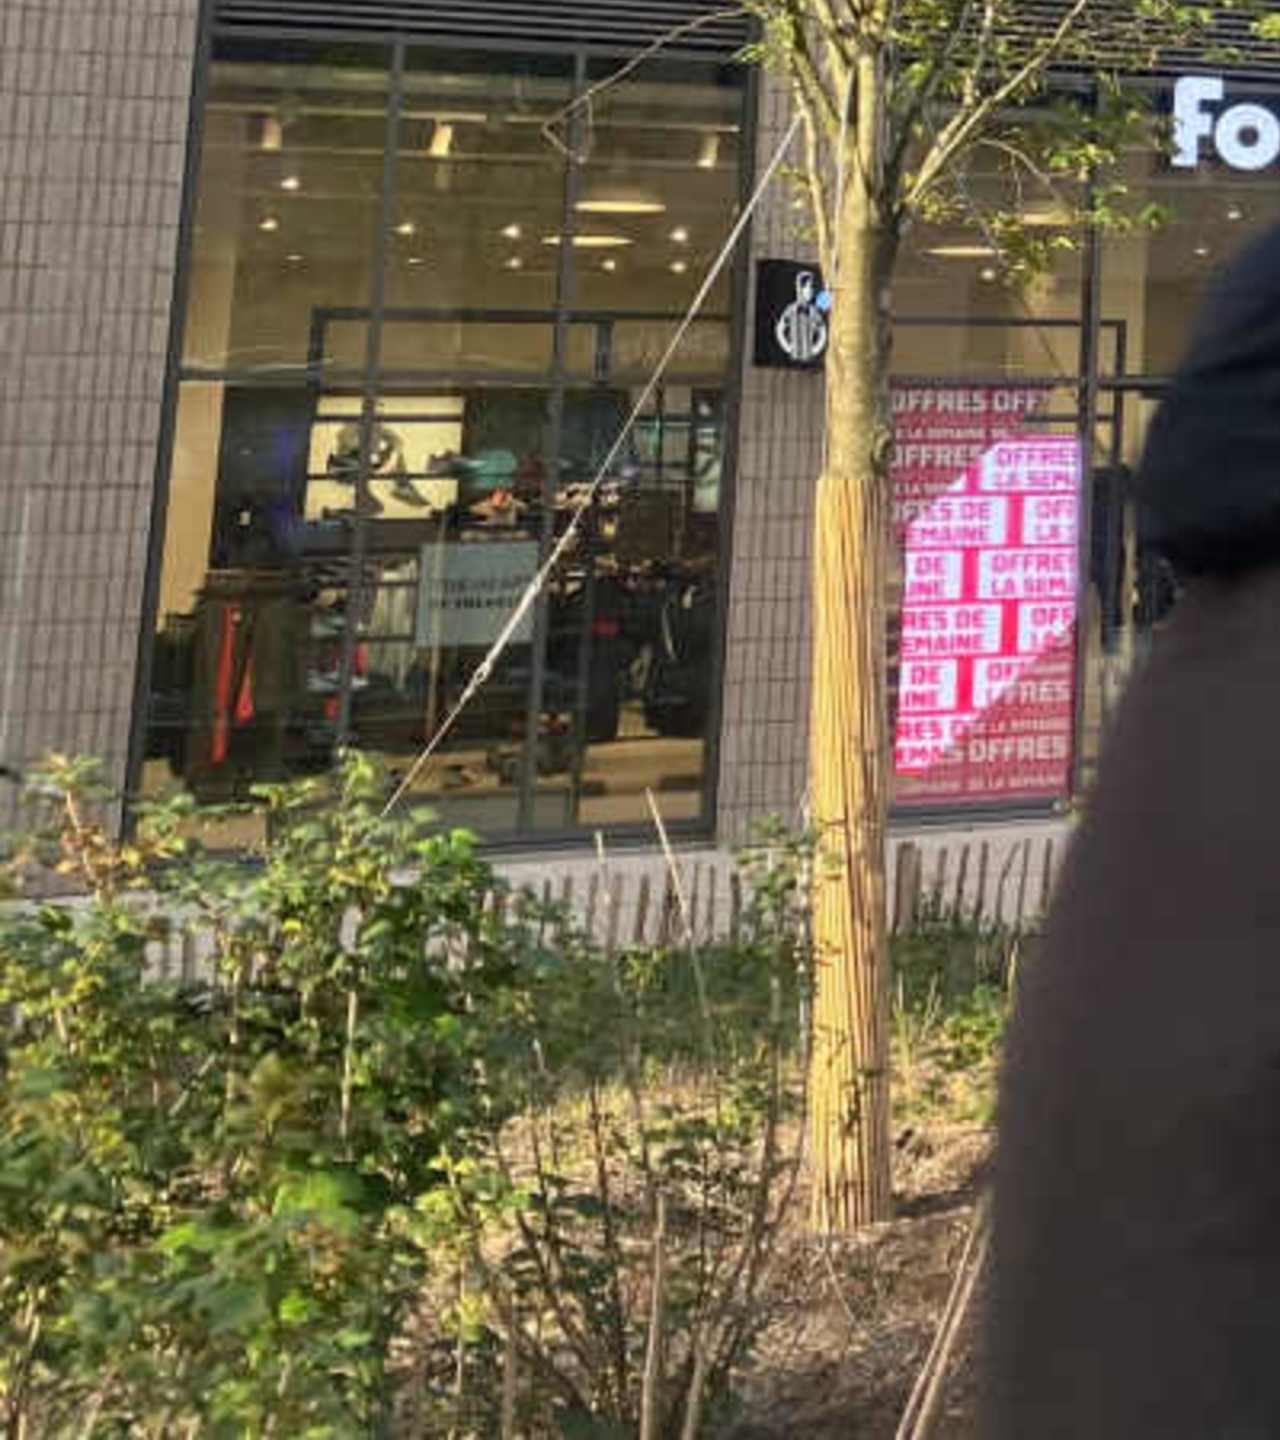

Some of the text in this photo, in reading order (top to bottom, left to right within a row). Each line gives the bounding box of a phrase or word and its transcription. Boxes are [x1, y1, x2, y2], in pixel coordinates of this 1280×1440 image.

[955, 608, 987, 630] DE
[911, 665, 941, 685] DE
[968, 734, 1069, 764] OFFRES
